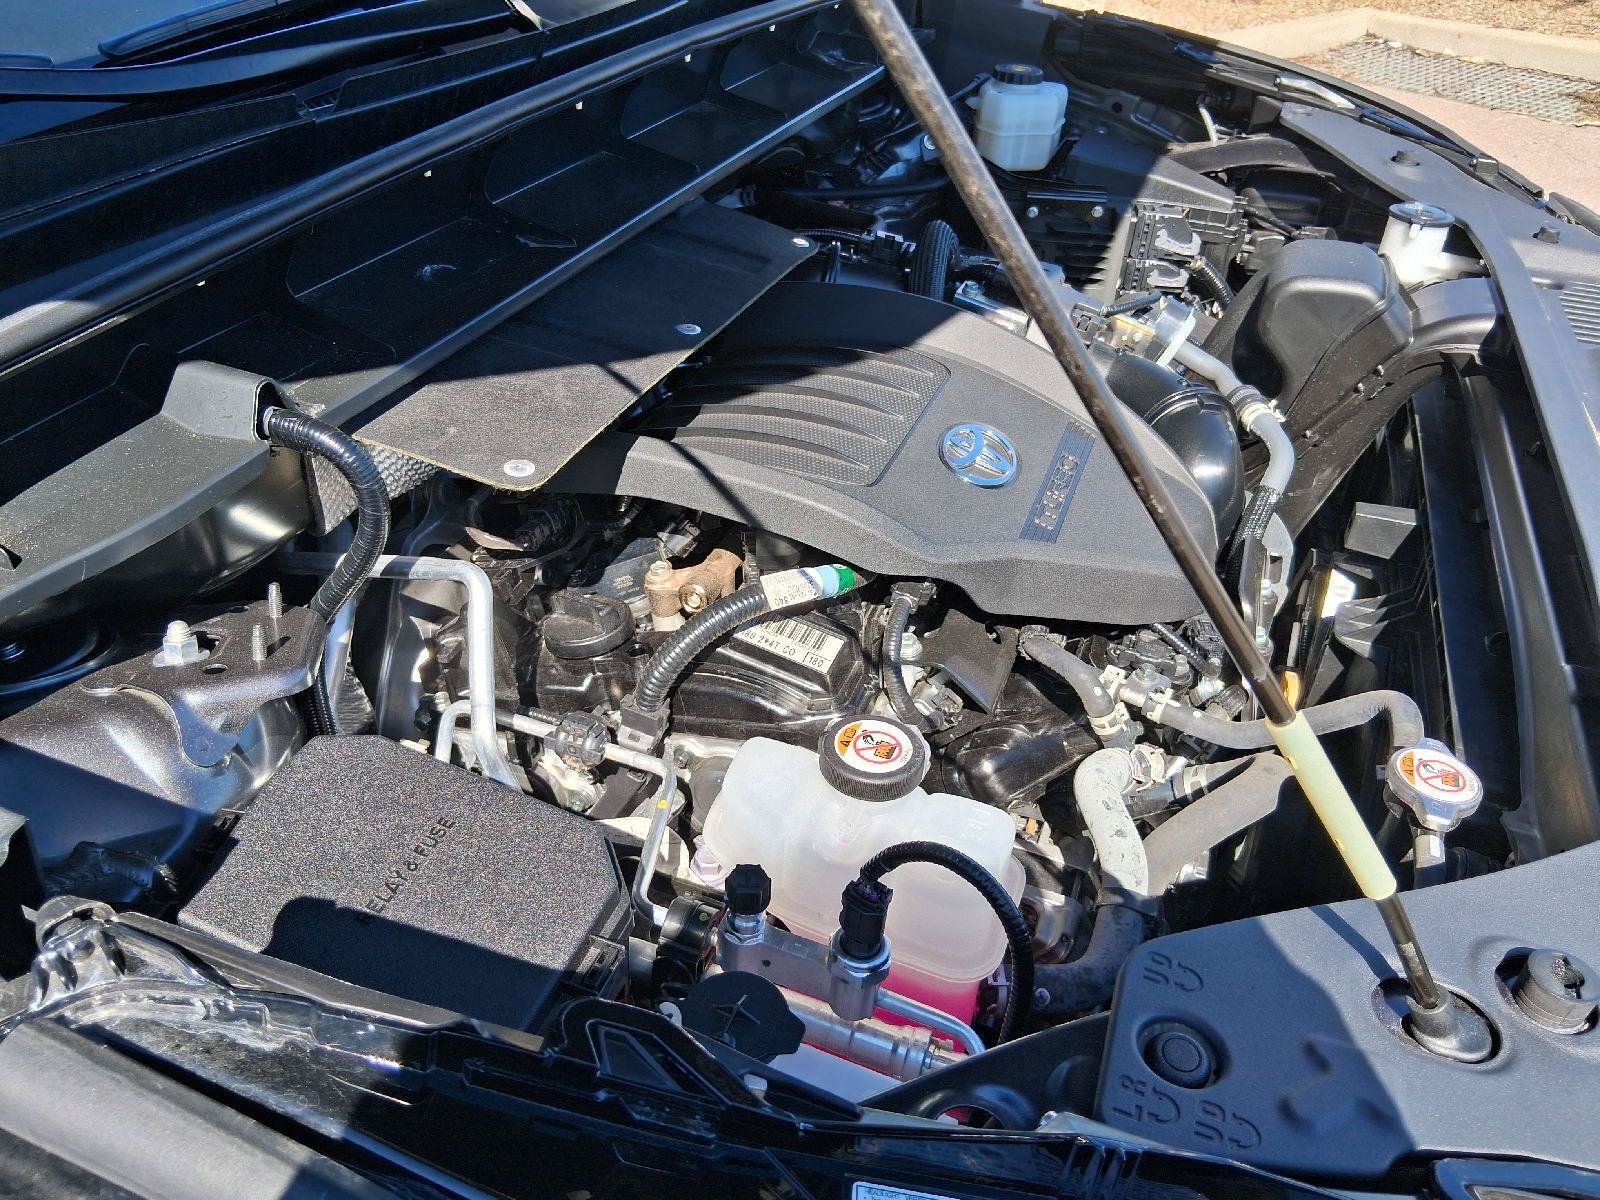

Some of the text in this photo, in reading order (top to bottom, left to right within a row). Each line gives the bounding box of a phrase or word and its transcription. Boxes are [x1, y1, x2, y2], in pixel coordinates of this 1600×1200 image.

[809, 656, 824, 667] 180
[354, 869, 408, 925] RELAY
[413, 817, 456, 857] FUSE
